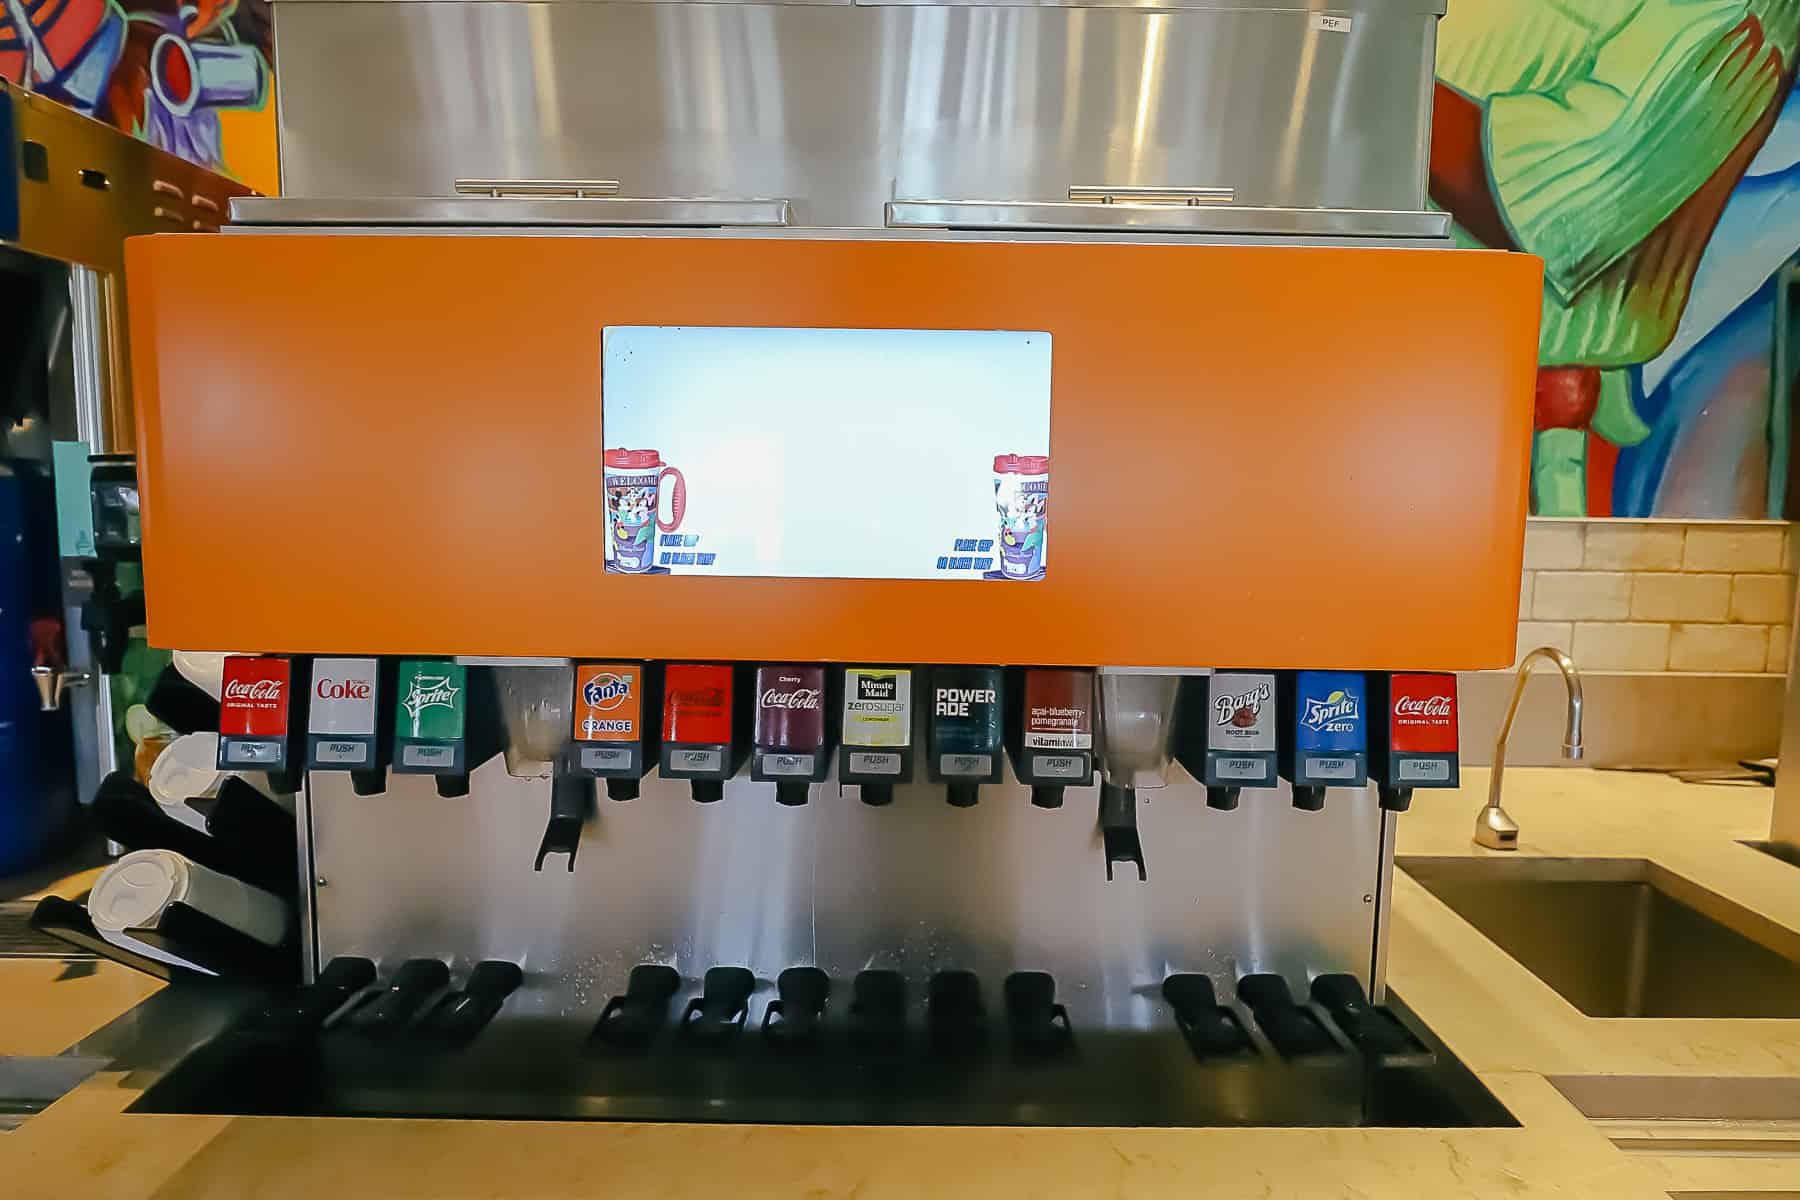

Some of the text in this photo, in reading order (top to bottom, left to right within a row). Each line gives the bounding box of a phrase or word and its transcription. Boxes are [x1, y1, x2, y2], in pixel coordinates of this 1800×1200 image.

[225, 680, 283, 699] Coca-Cola
[317, 679, 370, 699] Coke
[861, 680, 894, 690] Minute
[407, 687, 452, 706] Sprite
[583, 679, 628, 705] Fanta
[865, 688, 889, 698] Maid
[936, 689, 996, 703] POWER
[761, 688, 820, 709] Coca-Cola
[936, 703, 969, 716] ADE
[1215, 683, 1270, 726] Barq's
[1395, 696, 1452, 716] Coca-Cola
[1308, 699, 1355, 724] Sprite
[583, 720, 632, 732] ORANGE
[1326, 722, 1355, 732] zero
[329, 743, 355, 753] PUSH
[594, 750, 620, 760] PUSH
[683, 751, 710, 761] PUSH
[863, 755, 889, 764] PUSH
[954, 758, 979, 767] PUSH
[1046, 758, 1072, 768] PUSH
[1229, 760, 1255, 769] PUSH
[1318, 760, 1344, 769] PUSH
[1412, 761, 1438, 770] PUSH
